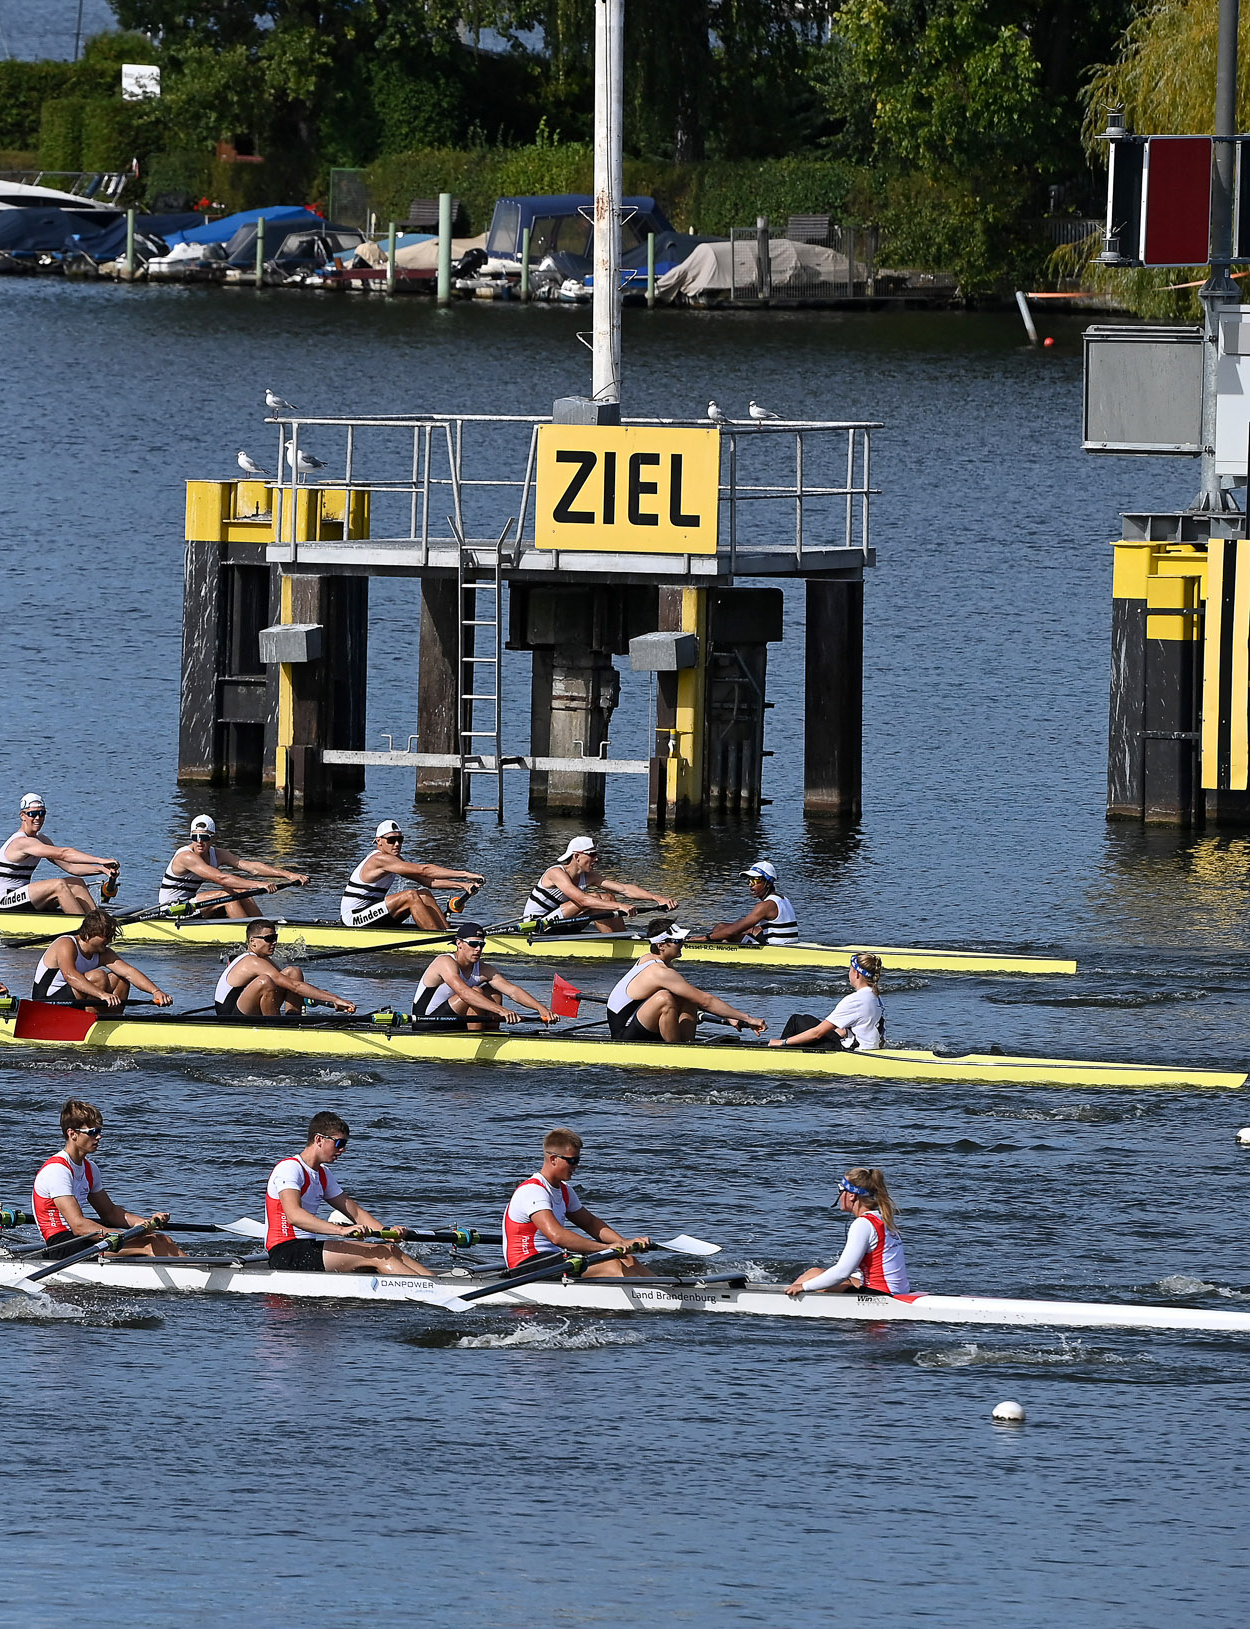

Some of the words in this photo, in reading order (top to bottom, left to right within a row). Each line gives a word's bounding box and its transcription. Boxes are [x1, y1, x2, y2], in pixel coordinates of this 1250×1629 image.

[553, 450, 700, 527] ZIEL
[353, 908, 384, 925] Minden
[381, 1280, 434, 1288] DANPOWER
[631, 1291, 653, 1299] Land
[656, 1291, 717, 1304] Brandenburg
